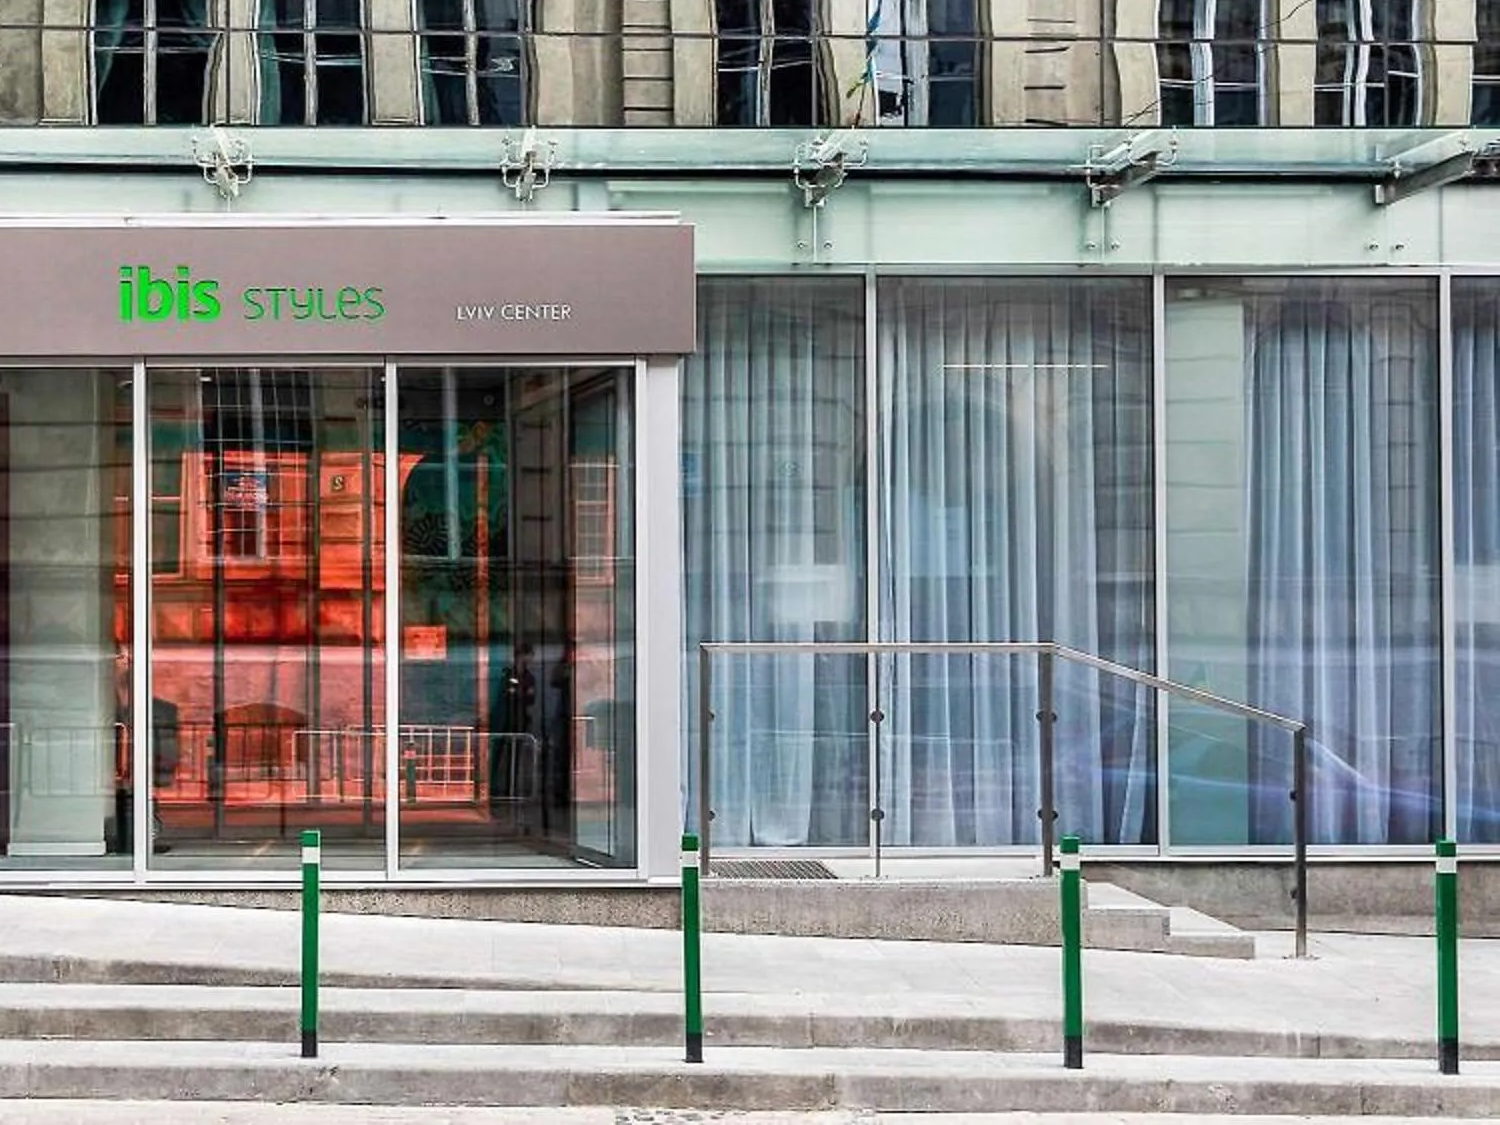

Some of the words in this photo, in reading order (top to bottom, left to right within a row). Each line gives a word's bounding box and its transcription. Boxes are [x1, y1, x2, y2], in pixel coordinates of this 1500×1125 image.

[118, 265, 221, 323] ibis
[456, 305, 496, 321] LVIV
[501, 304, 573, 321] CENTER
